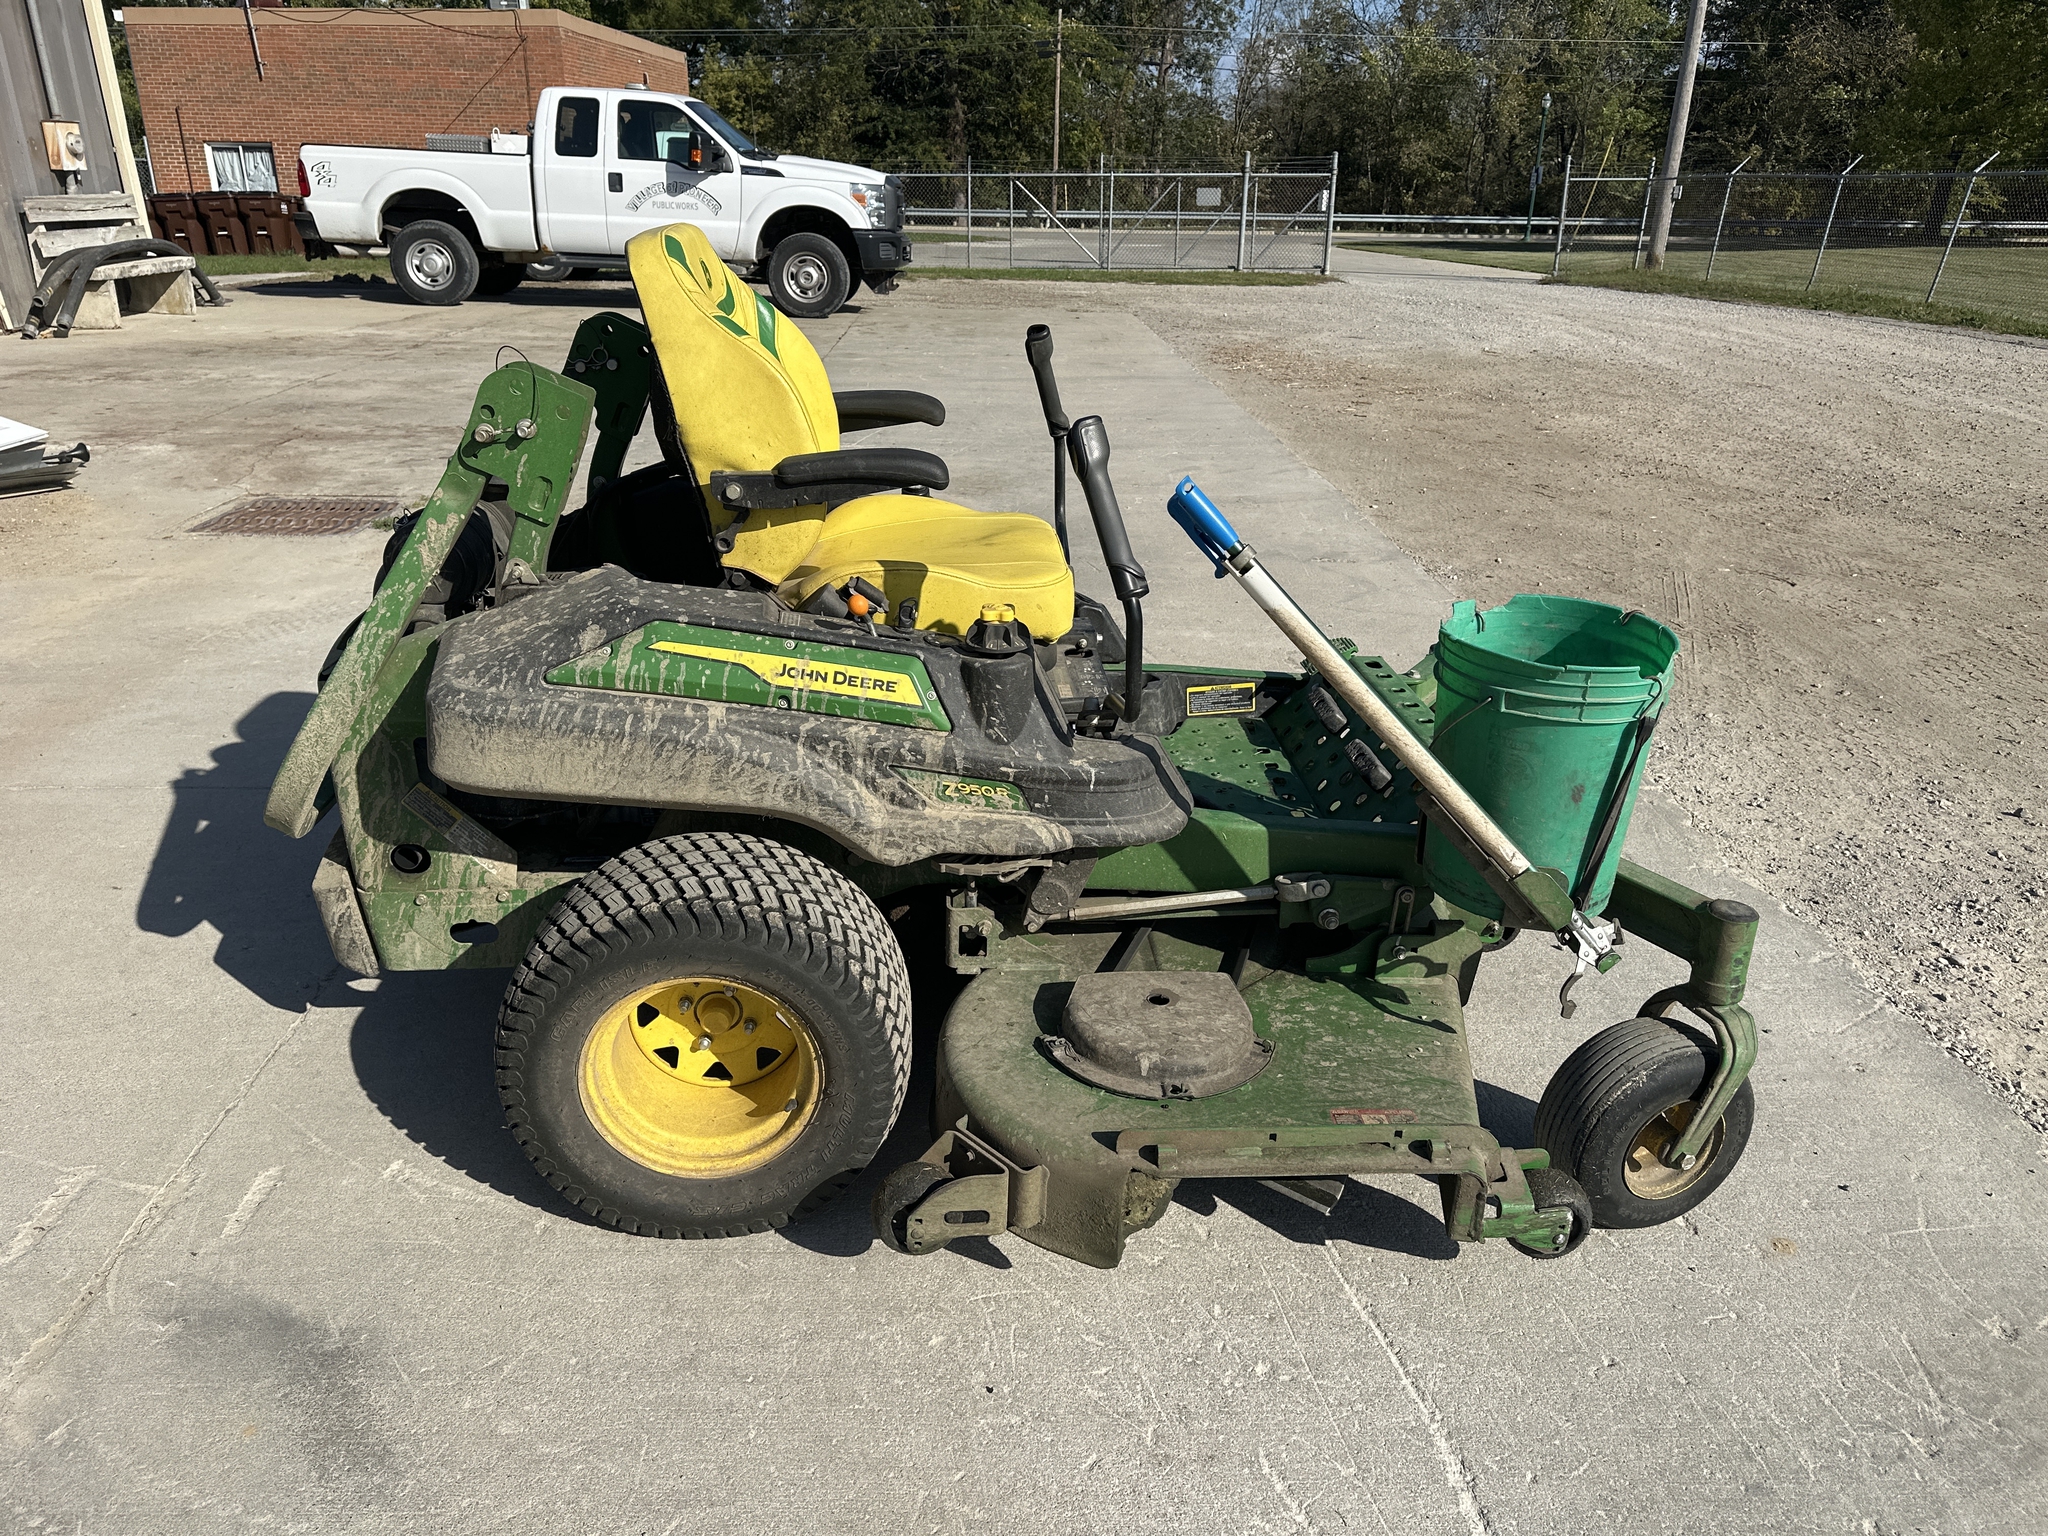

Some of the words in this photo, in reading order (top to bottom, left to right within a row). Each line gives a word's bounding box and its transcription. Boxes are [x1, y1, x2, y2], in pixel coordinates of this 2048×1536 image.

[625, 181, 667, 212] VILLAGE
[678, 181, 723, 217] PIONEER
[652, 200, 675, 210] PUBLIC
[675, 201, 699, 211] WORKS
[775, 663, 829, 685] JOHN
[831, 670, 898, 694] DEERE
[430, 792, 452, 813] CAUTION
